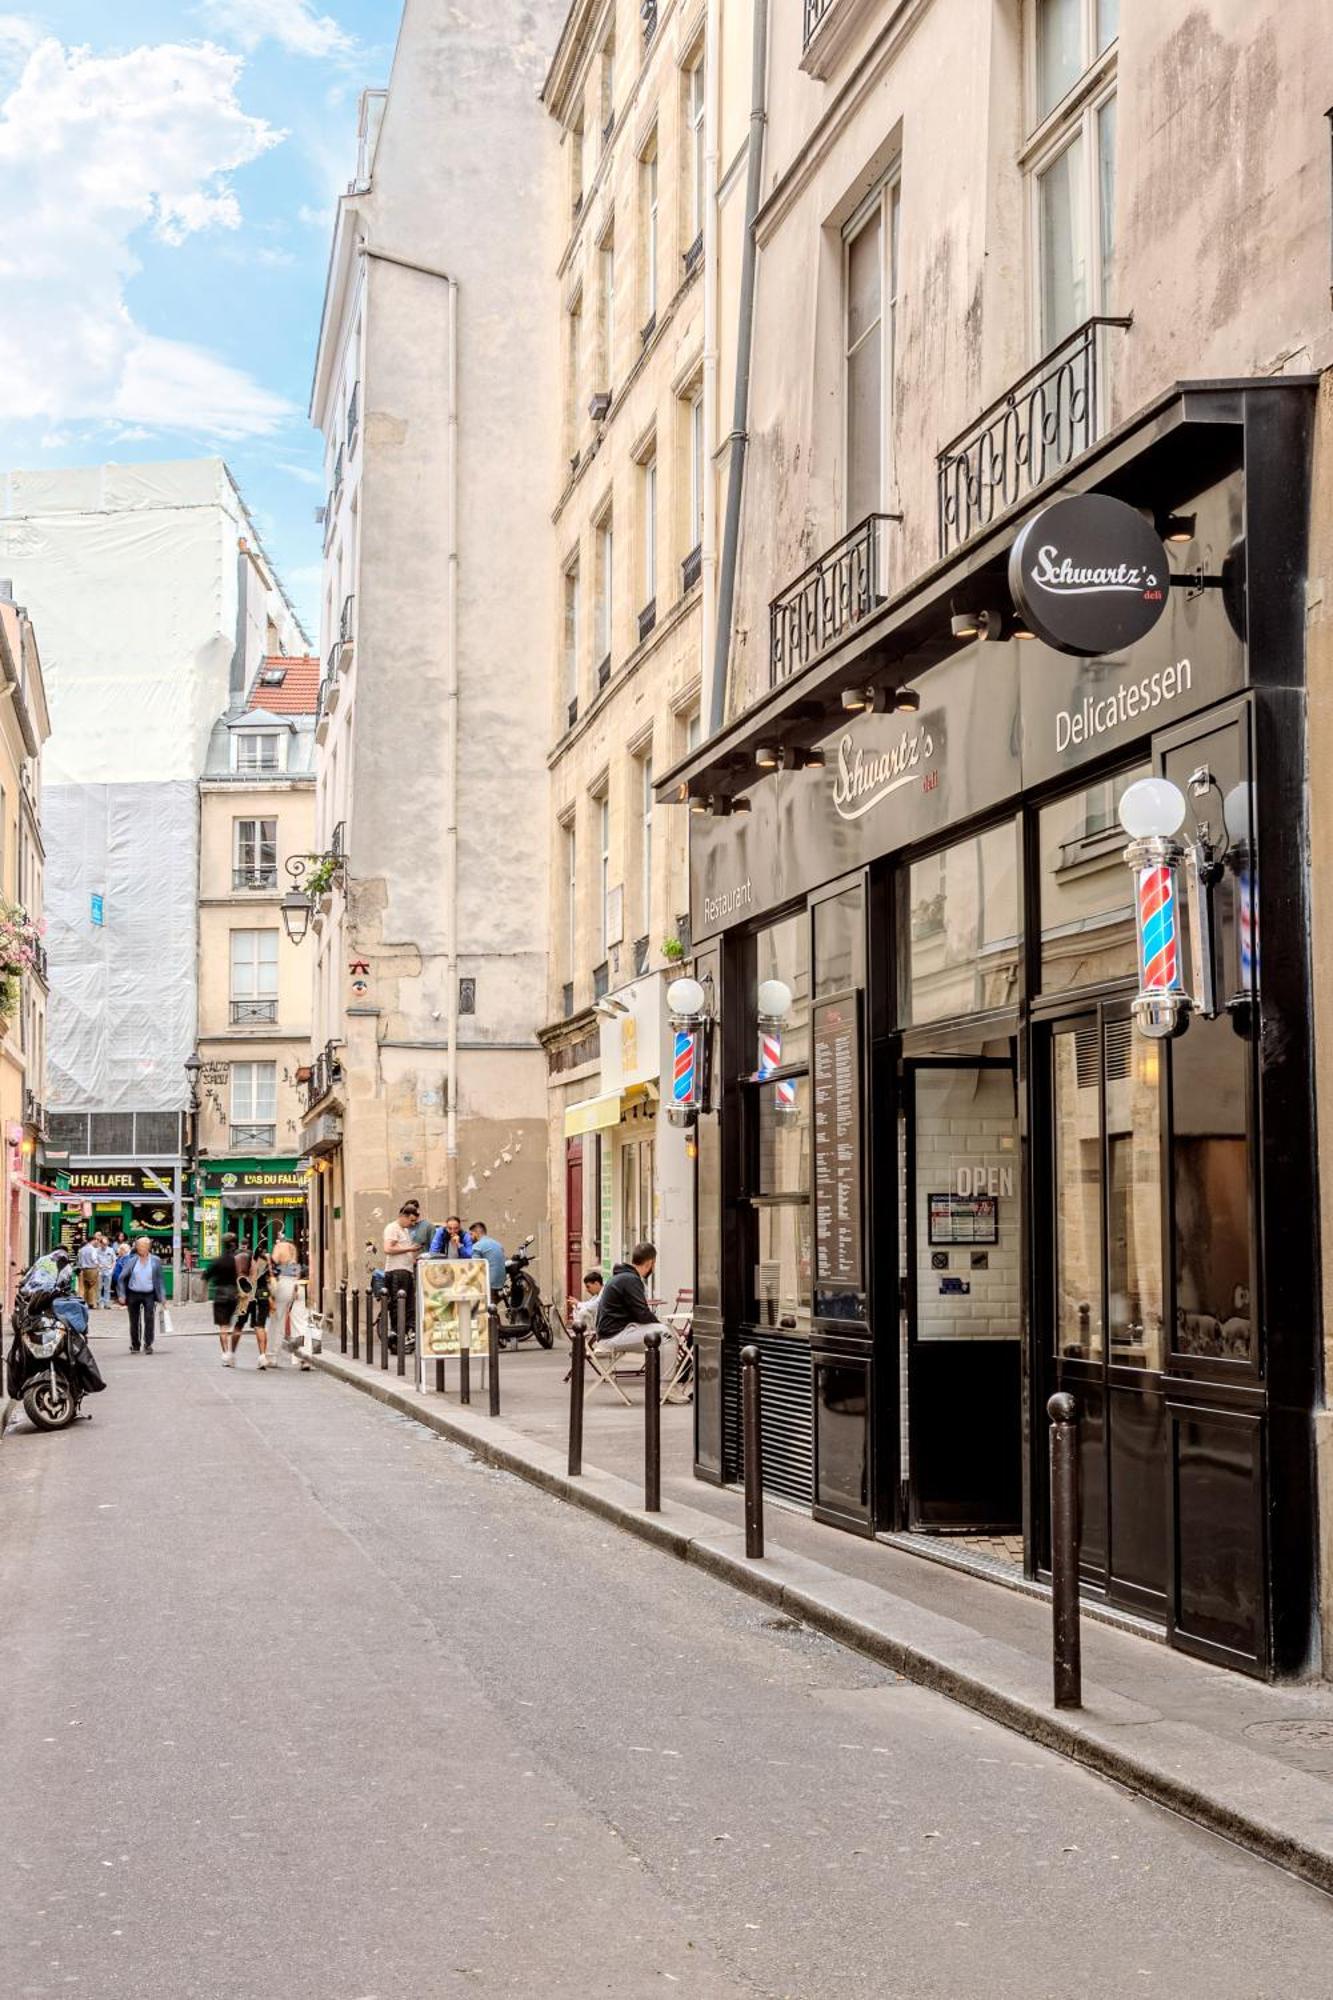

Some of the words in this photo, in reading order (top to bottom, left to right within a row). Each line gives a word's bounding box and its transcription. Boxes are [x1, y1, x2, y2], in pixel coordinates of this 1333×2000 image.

[1031, 545, 1157, 588] Schwartz's
[1144, 589, 1162, 600] deli
[1055, 658, 1192, 753] Delicatessen
[833, 726, 934, 804] Schwartz's
[704, 876, 752, 924] Restaurant
[81, 1174, 135, 1187] FALLAFEL
[264, 1174, 277, 1185] DU
[956, 1166, 1013, 1197] OPEN
